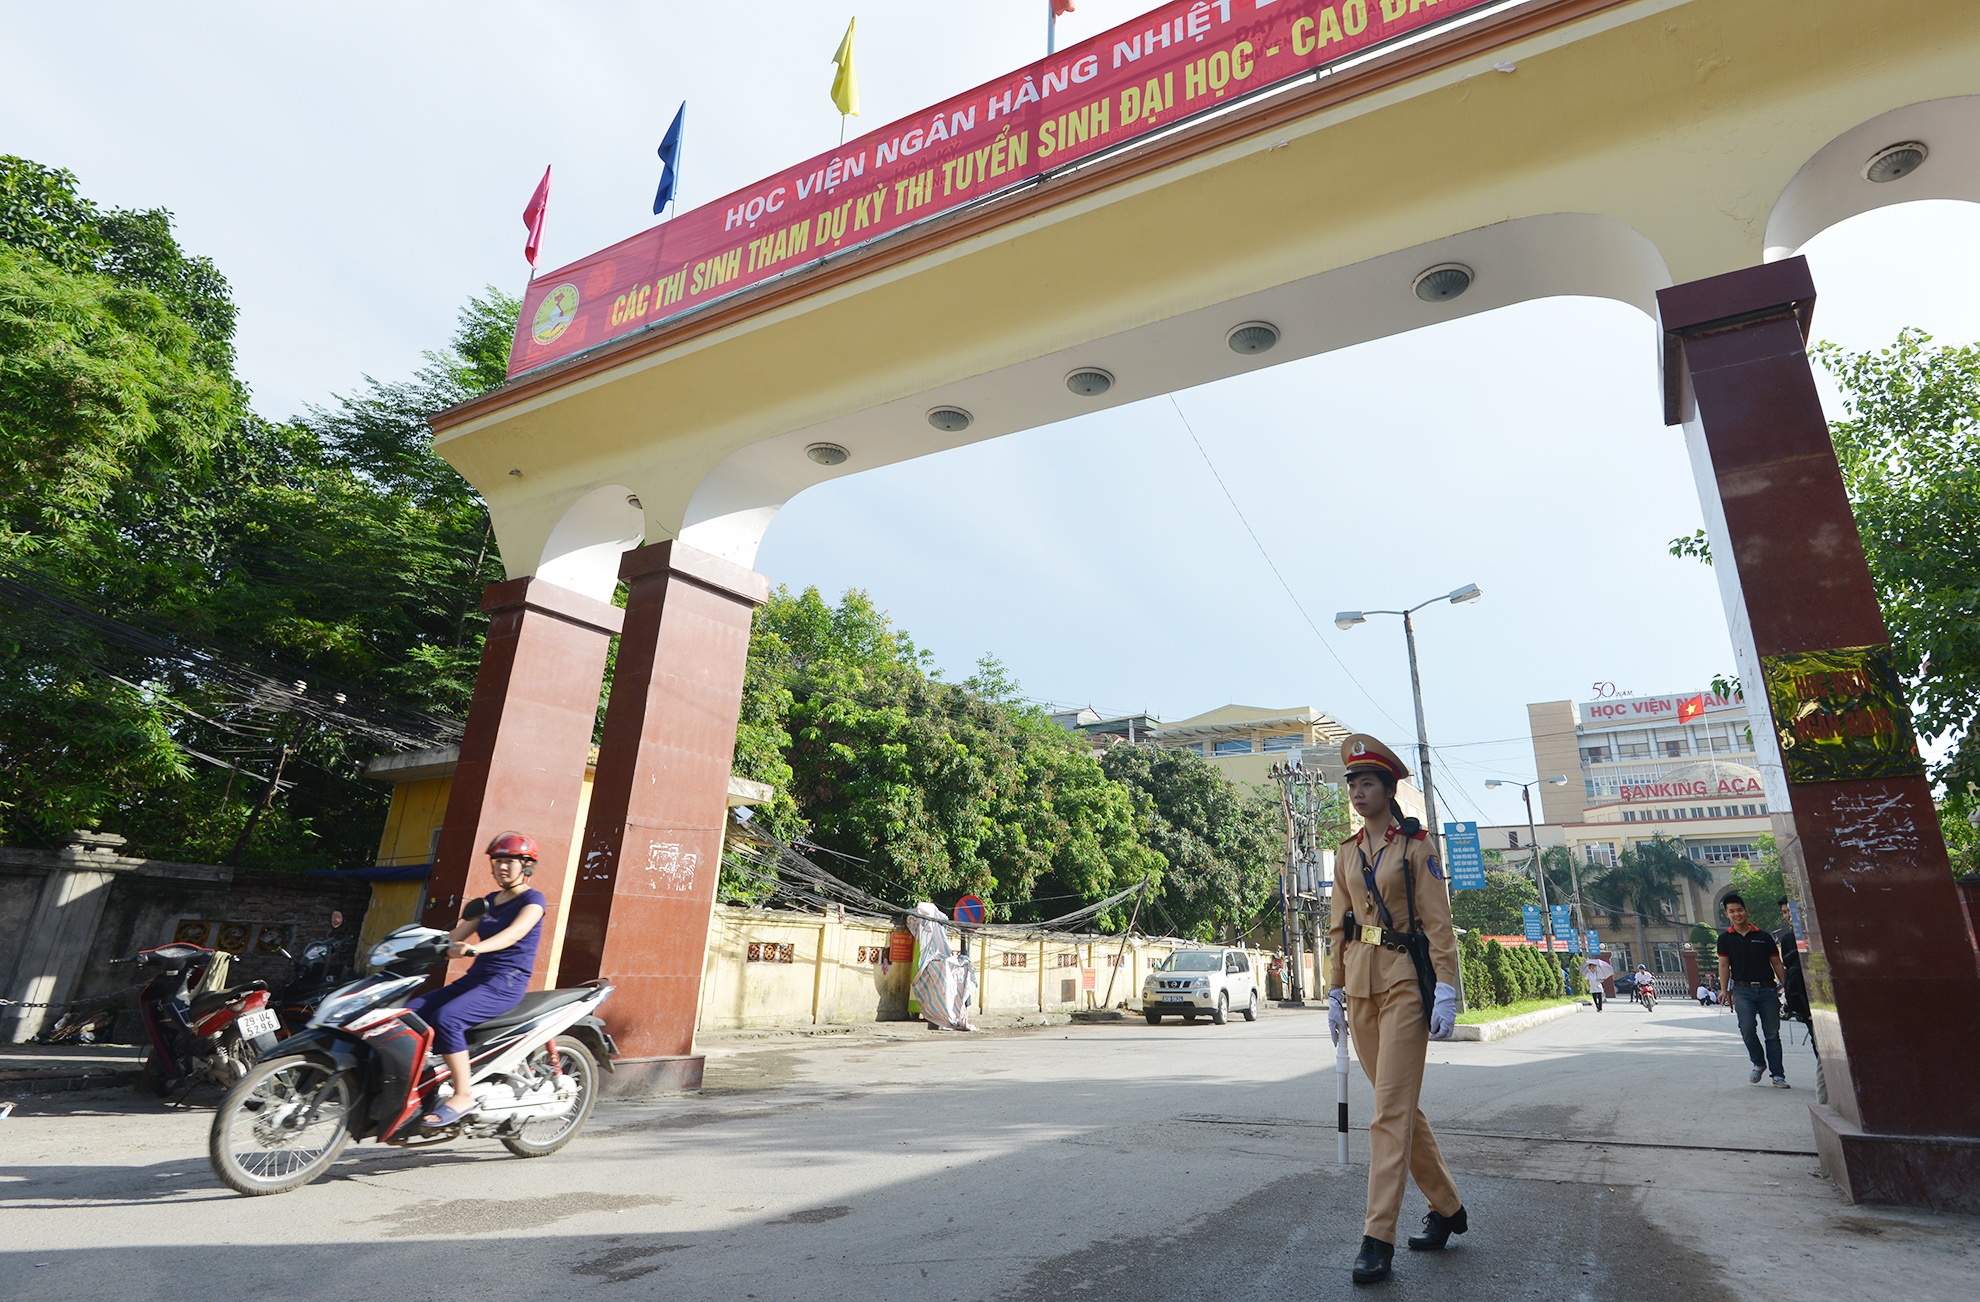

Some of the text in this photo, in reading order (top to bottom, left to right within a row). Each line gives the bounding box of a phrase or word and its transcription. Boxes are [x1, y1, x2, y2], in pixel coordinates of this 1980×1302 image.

[724, 187, 786, 232] HỌC
[795, 151, 866, 200] VIỆN
[875, 105, 976, 168] NGÂN
[987, 54, 1098, 121] HÀNG
[1113, 0, 1231, 69] NHIỆT
[611, 283, 651, 327] CÁC
[655, 262, 689, 310] THÍ
[690, 247, 743, 296] SINH
[748, 219, 811, 274] THAM
[814, 198, 852, 247] DỰ
[854, 183, 888, 232] KỲ
[894, 168, 934, 215] THI
[942, 124, 1029, 196] TUYỂN
[1037, 97, 1110, 158] SINH
[1119, 71, 1174, 127] ĐẠI
[1185, 41, 1254, 100] HỌC
[1266, 45, 1280, 57] -
[1291, 0, 1368, 56] CAO
[1593, 681, 1616, 700] 50
[1794, 665, 1872, 703] HỌC VIỆN
[1590, 703, 1627, 719] HỌC
[1632, 698, 1672, 715] VIỆN
[1793, 705, 1894, 740] NGÂN HÀNG
[1619, 780, 1707, 799] BANKING
[244, 1012, 270, 1027] 29-U4
[247, 1021, 274, 1036] 5296
